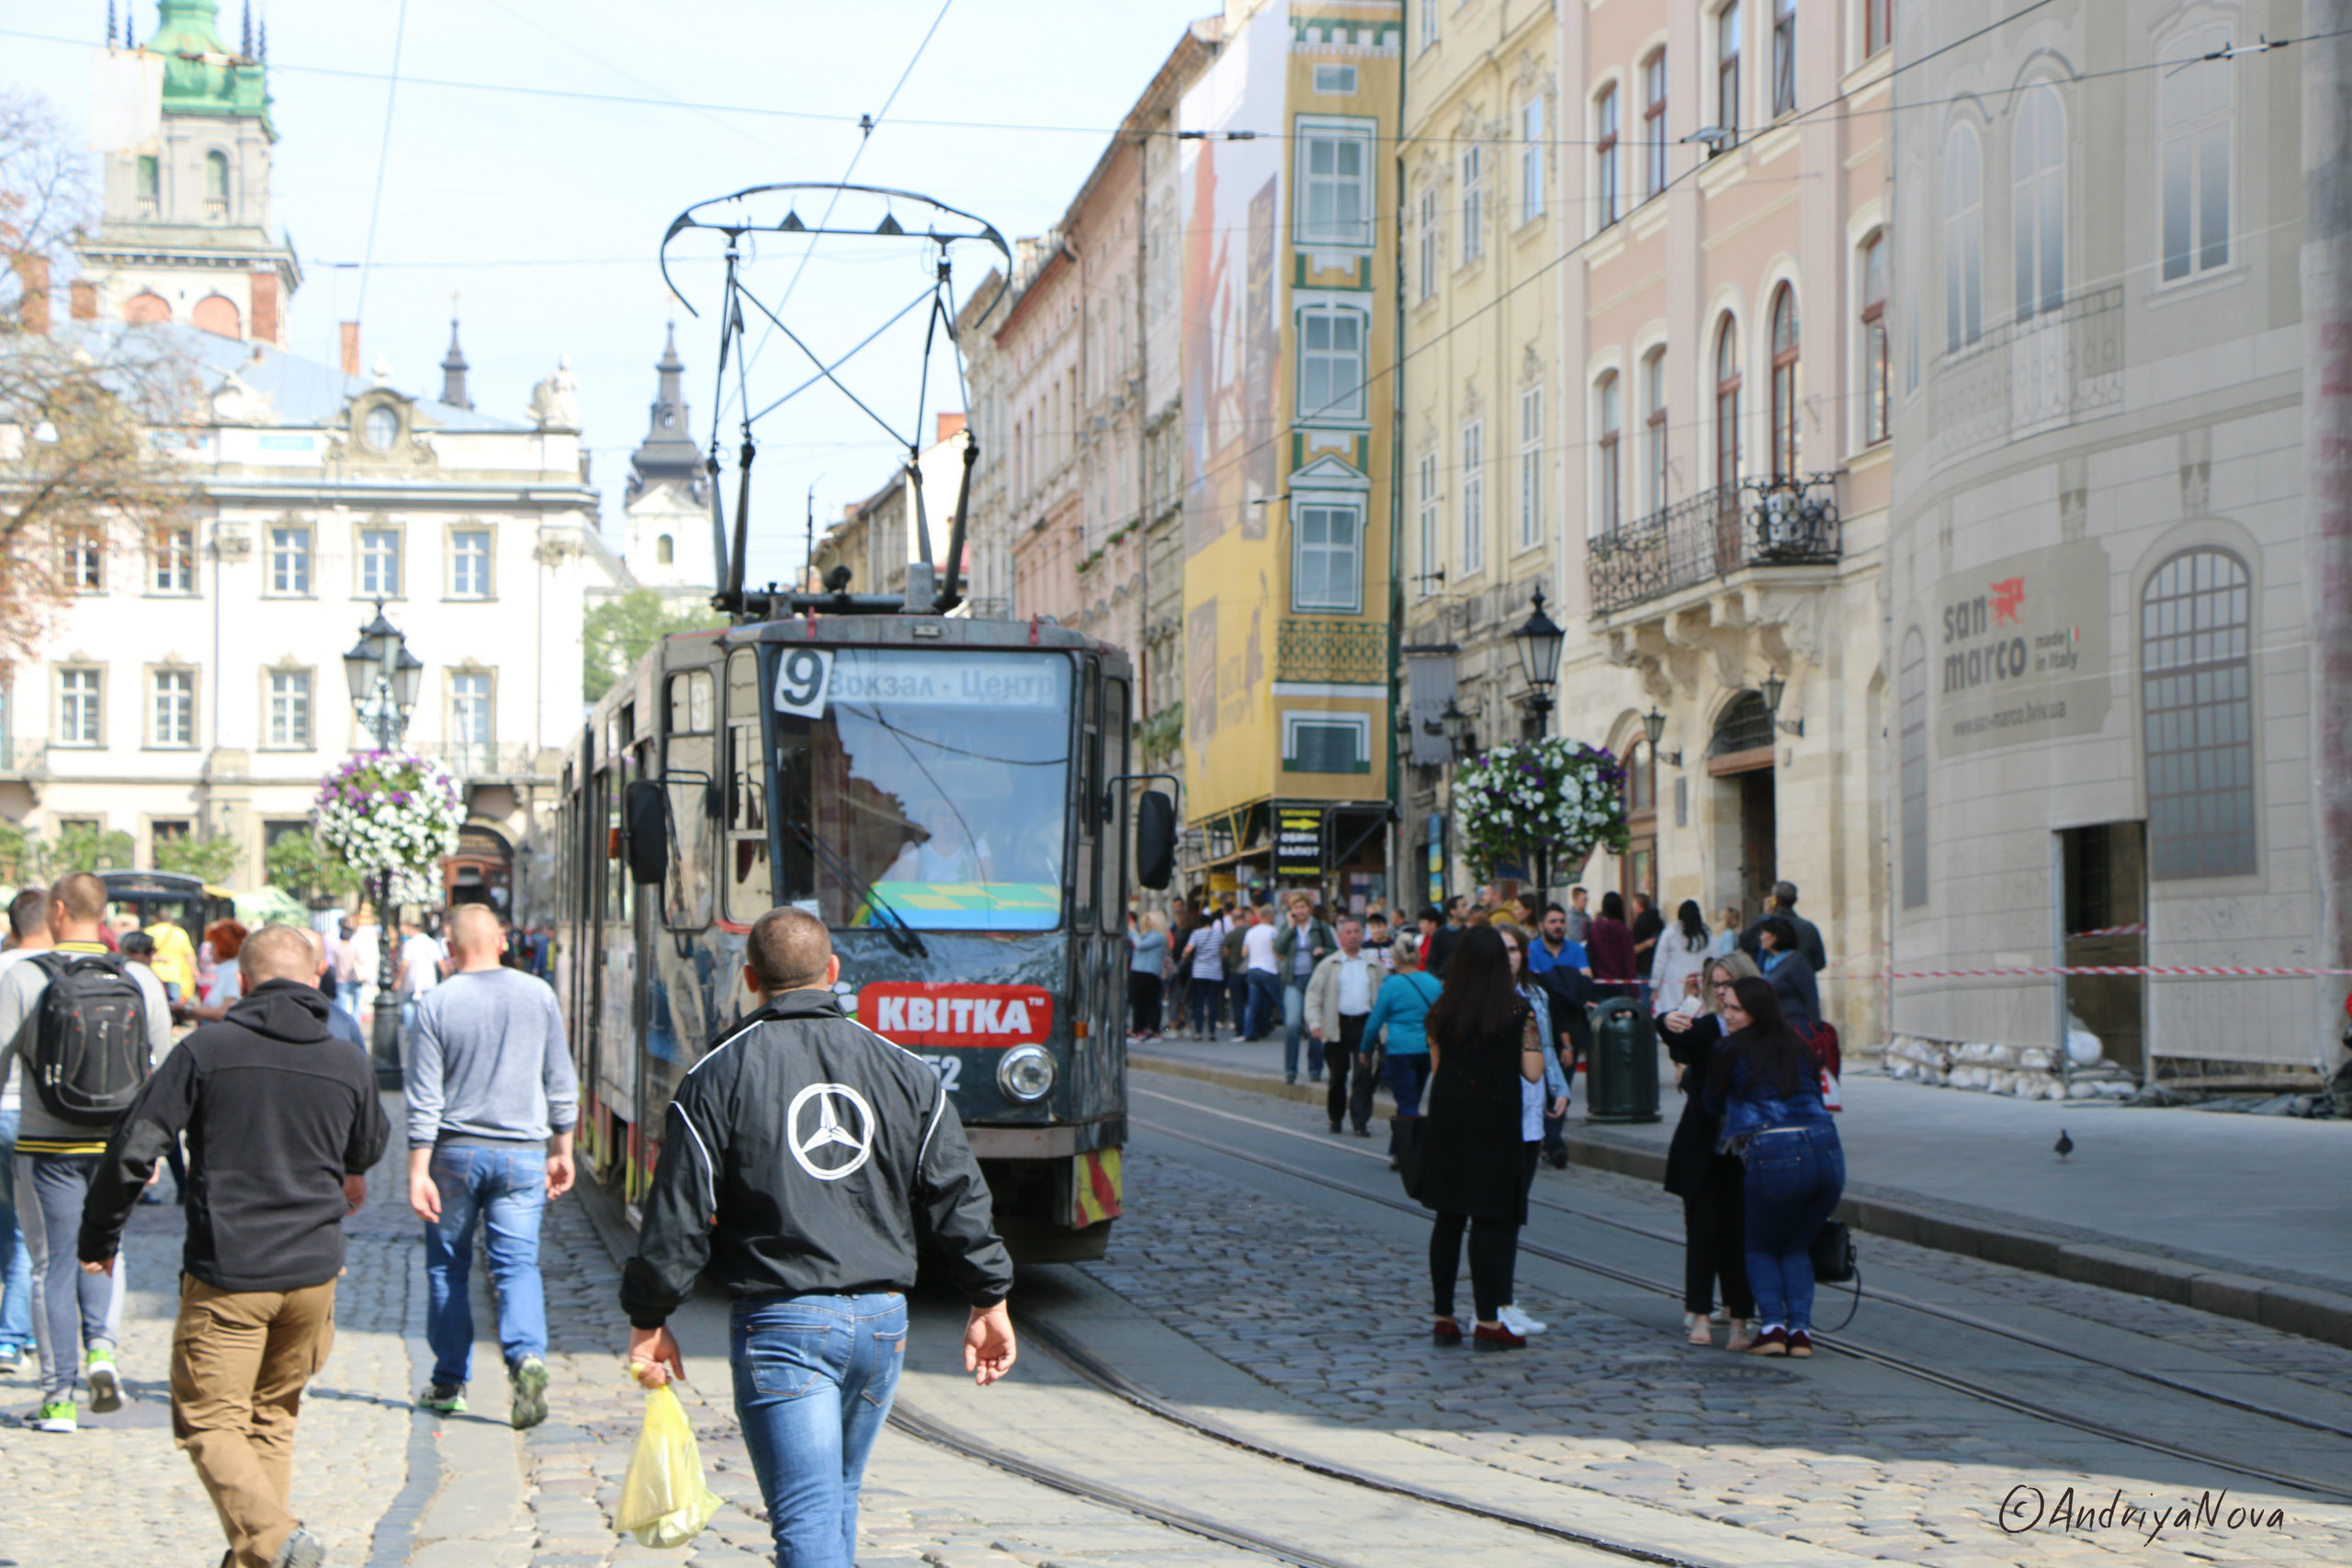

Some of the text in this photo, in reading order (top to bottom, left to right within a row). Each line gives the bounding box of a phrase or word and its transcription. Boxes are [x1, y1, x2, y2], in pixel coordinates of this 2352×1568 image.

[1943, 595, 1986, 644] san
[2035, 628, 2065, 649] made
[781, 649, 823, 707] 9
[828, 669, 934, 697] Вокзал
[961, 669, 1053, 704] Центр
[1943, 637, 2027, 693] marco
[877, 996, 1032, 1034] КВІТКА
